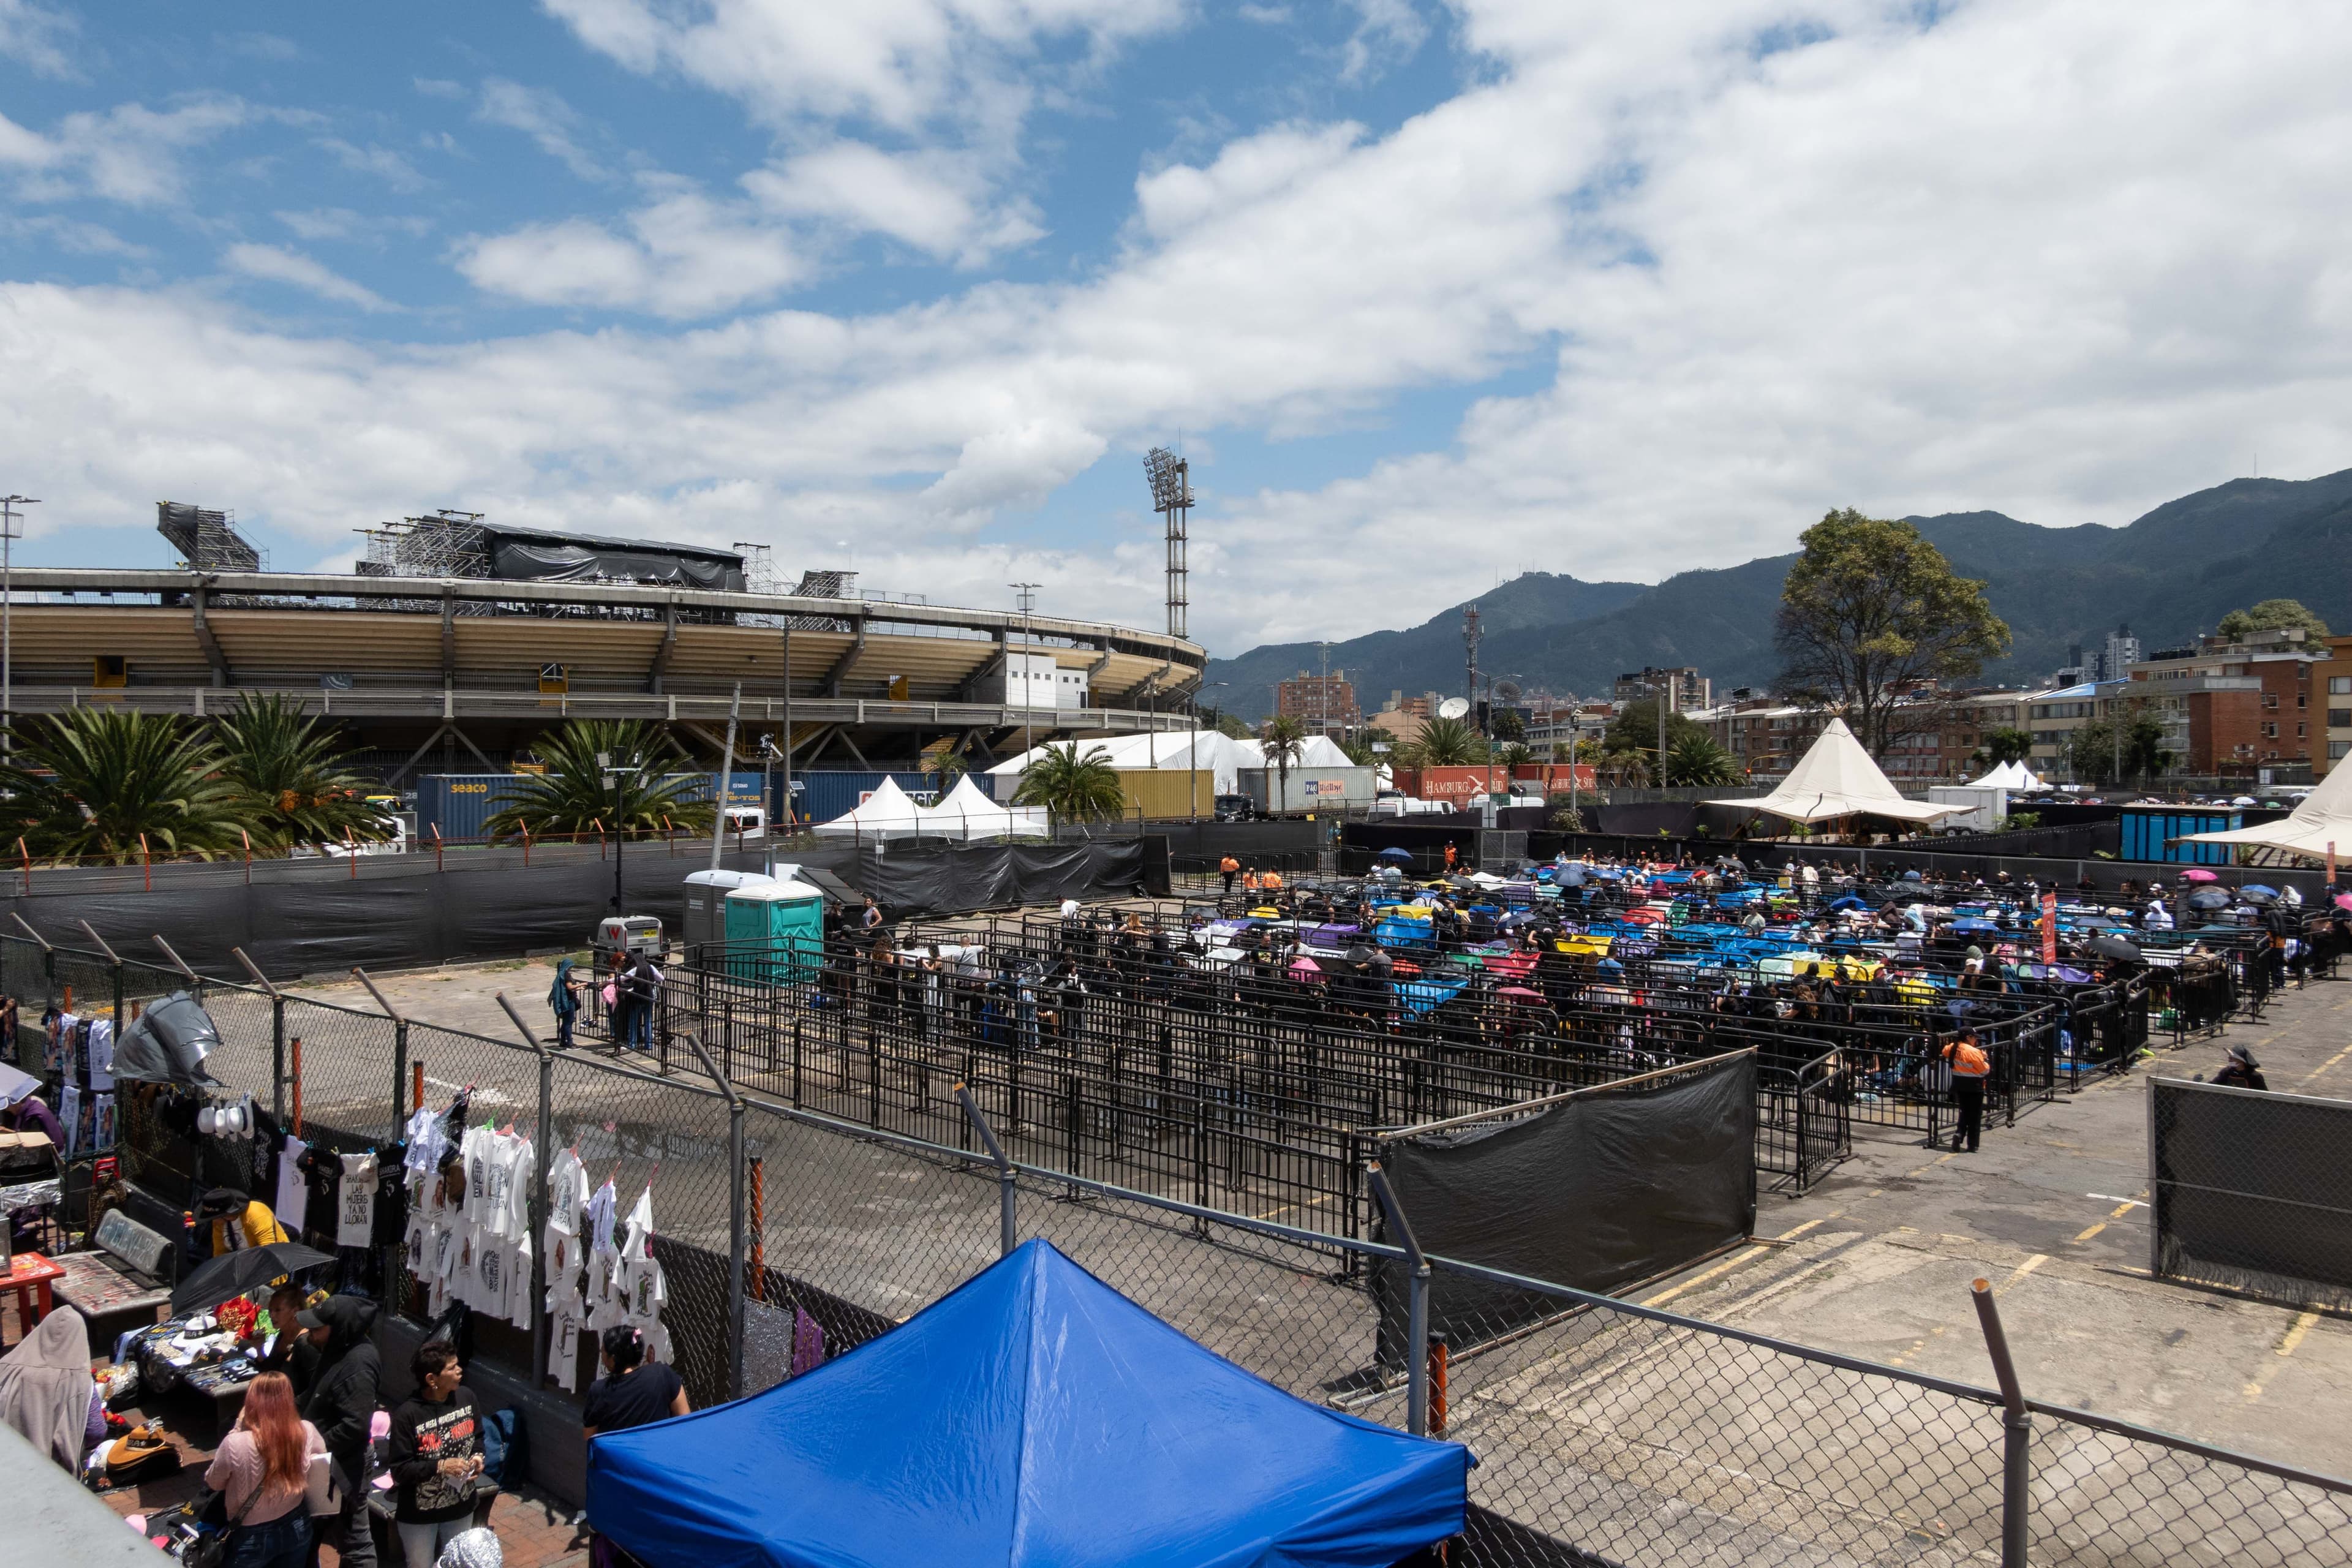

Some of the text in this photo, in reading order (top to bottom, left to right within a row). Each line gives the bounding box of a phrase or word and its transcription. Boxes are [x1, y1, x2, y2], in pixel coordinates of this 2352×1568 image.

[451, 784, 488, 793] seaco
[1426, 778, 1503, 794] HAMBURG ÜD
[352, 1185, 363, 1194] LAS
